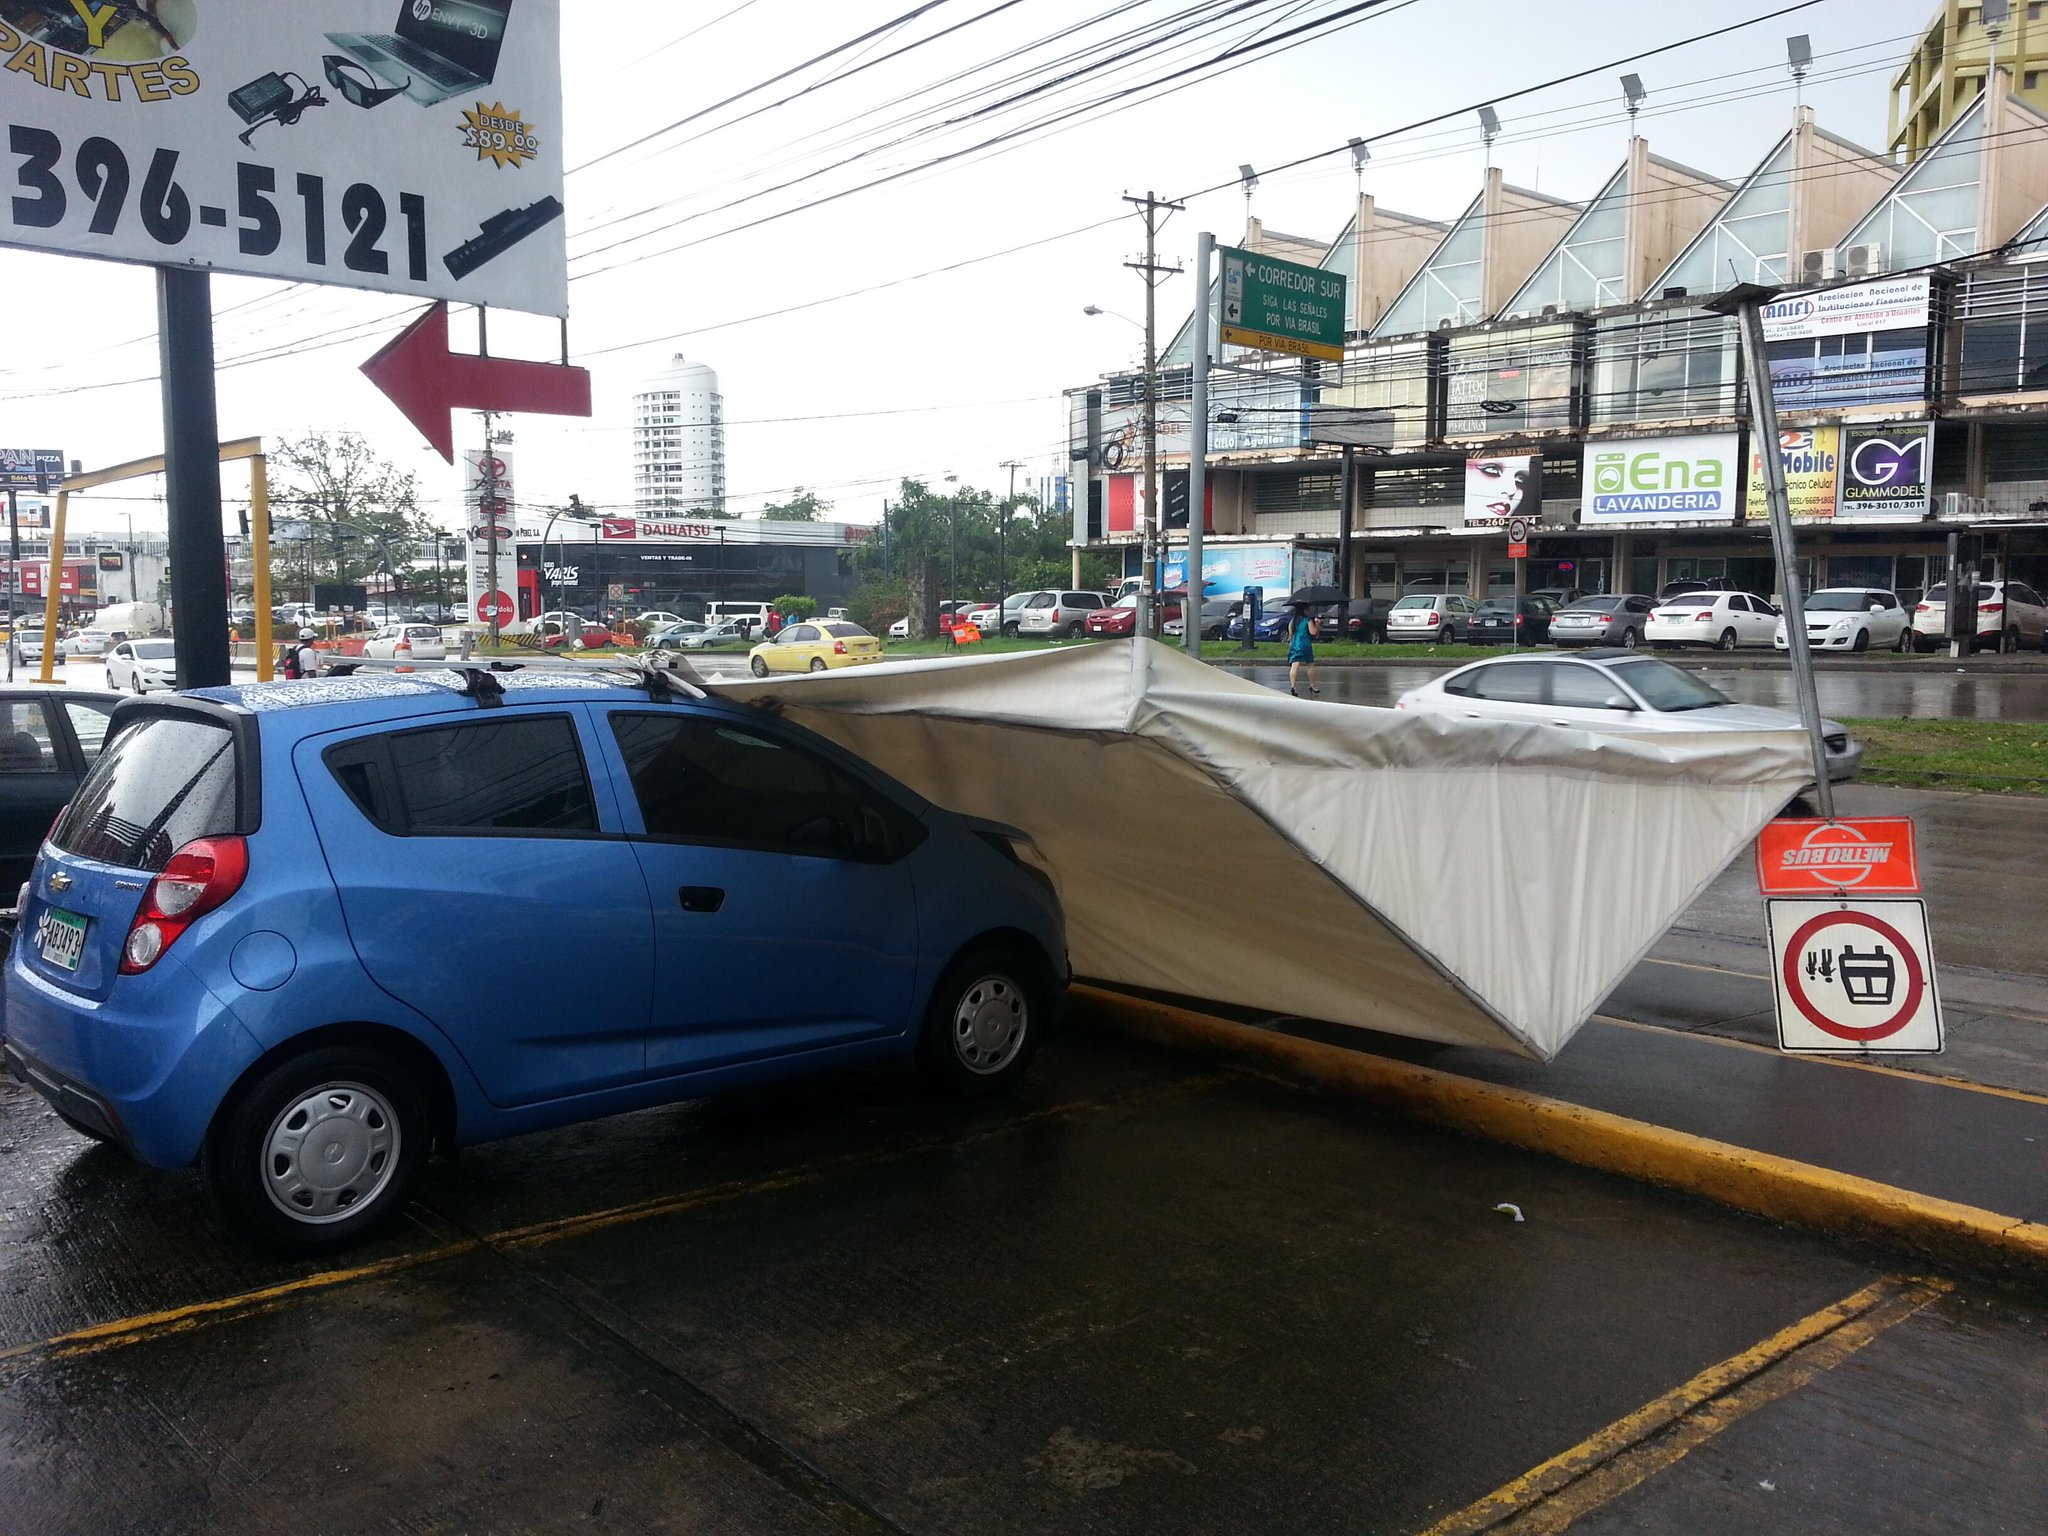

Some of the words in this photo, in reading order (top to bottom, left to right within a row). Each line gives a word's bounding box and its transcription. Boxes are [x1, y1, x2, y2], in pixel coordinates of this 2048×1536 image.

[431, 8, 463, 30] ENVY
[469, 22, 488, 39] 3D
[479, 114, 524, 134] DESDE
[8, 124, 428, 282] 396-5121
[1258, 264, 1316, 294] CORREDOR
[1320, 280, 1341, 299] SUR
[1869, 285, 1909, 296] Nacional
[1911, 283, 1923, 291] de
[1262, 294, 1279, 308] SIGA
[1282, 298, 1297, 312] LAS
[1299, 301, 1328, 319] SEÑALES
[1266, 313, 1281, 327] POR
[1284, 316, 1297, 330] VIA
[1298, 319, 1322, 335] BRASIL
[1259, 335, 1273, 347] POR
[1274, 337, 1286, 349] VIA
[1288, 340, 1310, 354] BRASIL
[36, 455, 61, 463] PIZZA
[1629, 452, 1723, 490] Ena
[473, 479, 512, 488] TOOTA
[1808, 478, 1833, 490] Celular
[1845, 486, 1926, 498] GLAMMODELS
[1596, 494, 1718, 512] LAVANDERIA
[1856, 501, 1925, 510] 396-3010/3011
[642, 523, 710, 536] DAIHATSU
